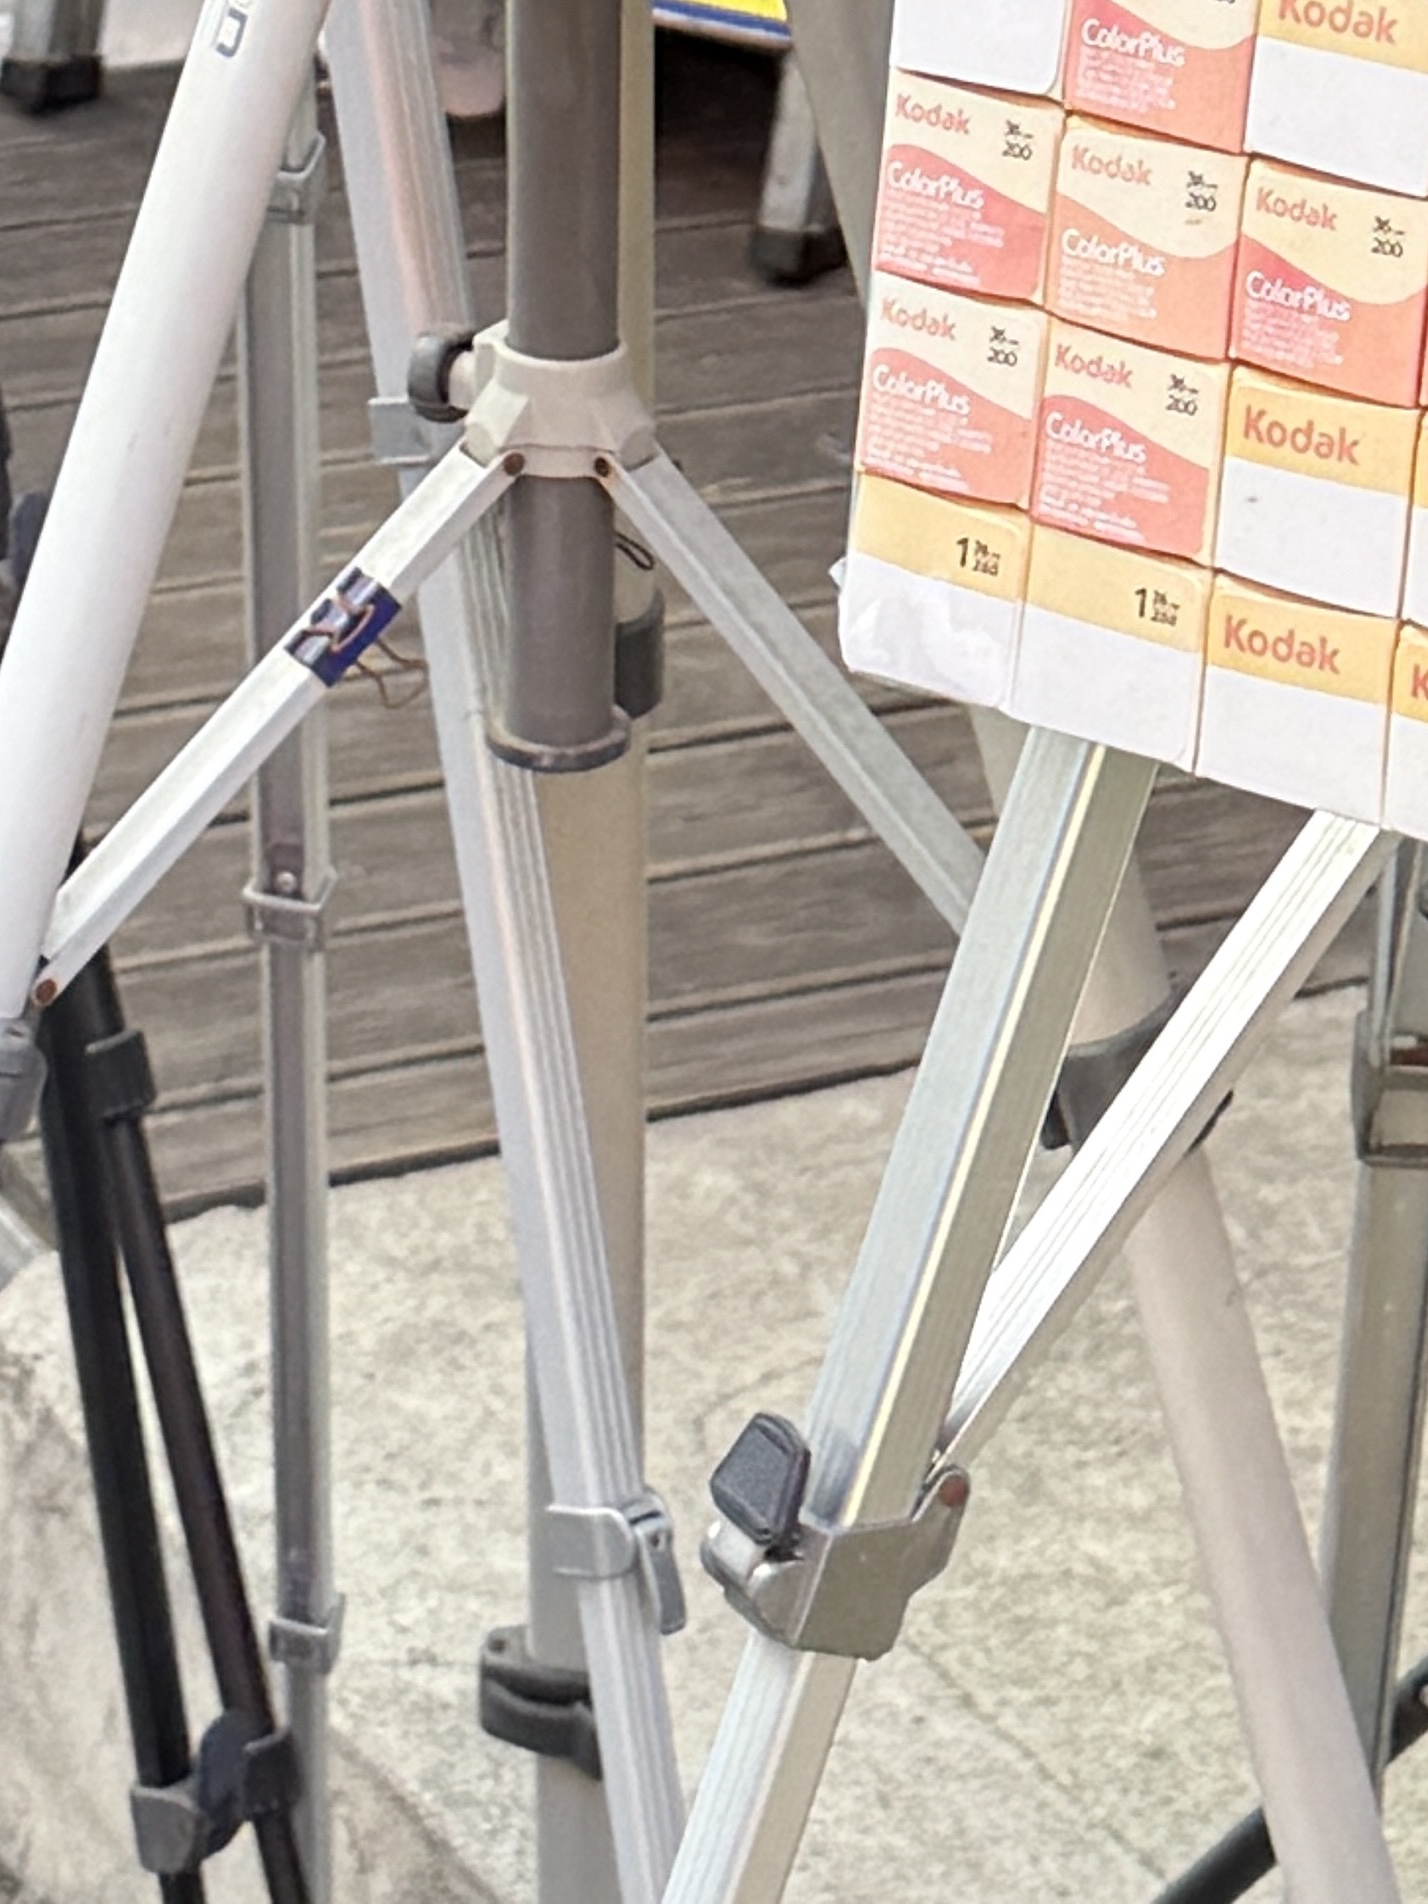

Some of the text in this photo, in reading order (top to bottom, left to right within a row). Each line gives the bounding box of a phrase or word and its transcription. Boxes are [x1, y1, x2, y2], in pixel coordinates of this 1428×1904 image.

[1081, 17, 1187, 67] ColorPlus
[894, 92, 971, 136] Kodak
[886, 159, 985, 210] ColorPlus
[1071, 144, 1153, 187] Kodak
[1255, 186, 1339, 232] Kodak
[1060, 227, 1167, 277] ColorPlus
[1370, 236, 1404, 259] 200
[880, 295, 957, 342] Kodak
[1245, 270, 1352, 323] ColorPlus
[871, 363, 971, 416] ColorPlus
[1054, 342, 1135, 390] Kodak
[1044, 410, 1148, 464] ColorPlus
[1242, 403, 1362, 467] Kodak
[1222, 613, 1342, 677] Kodak
